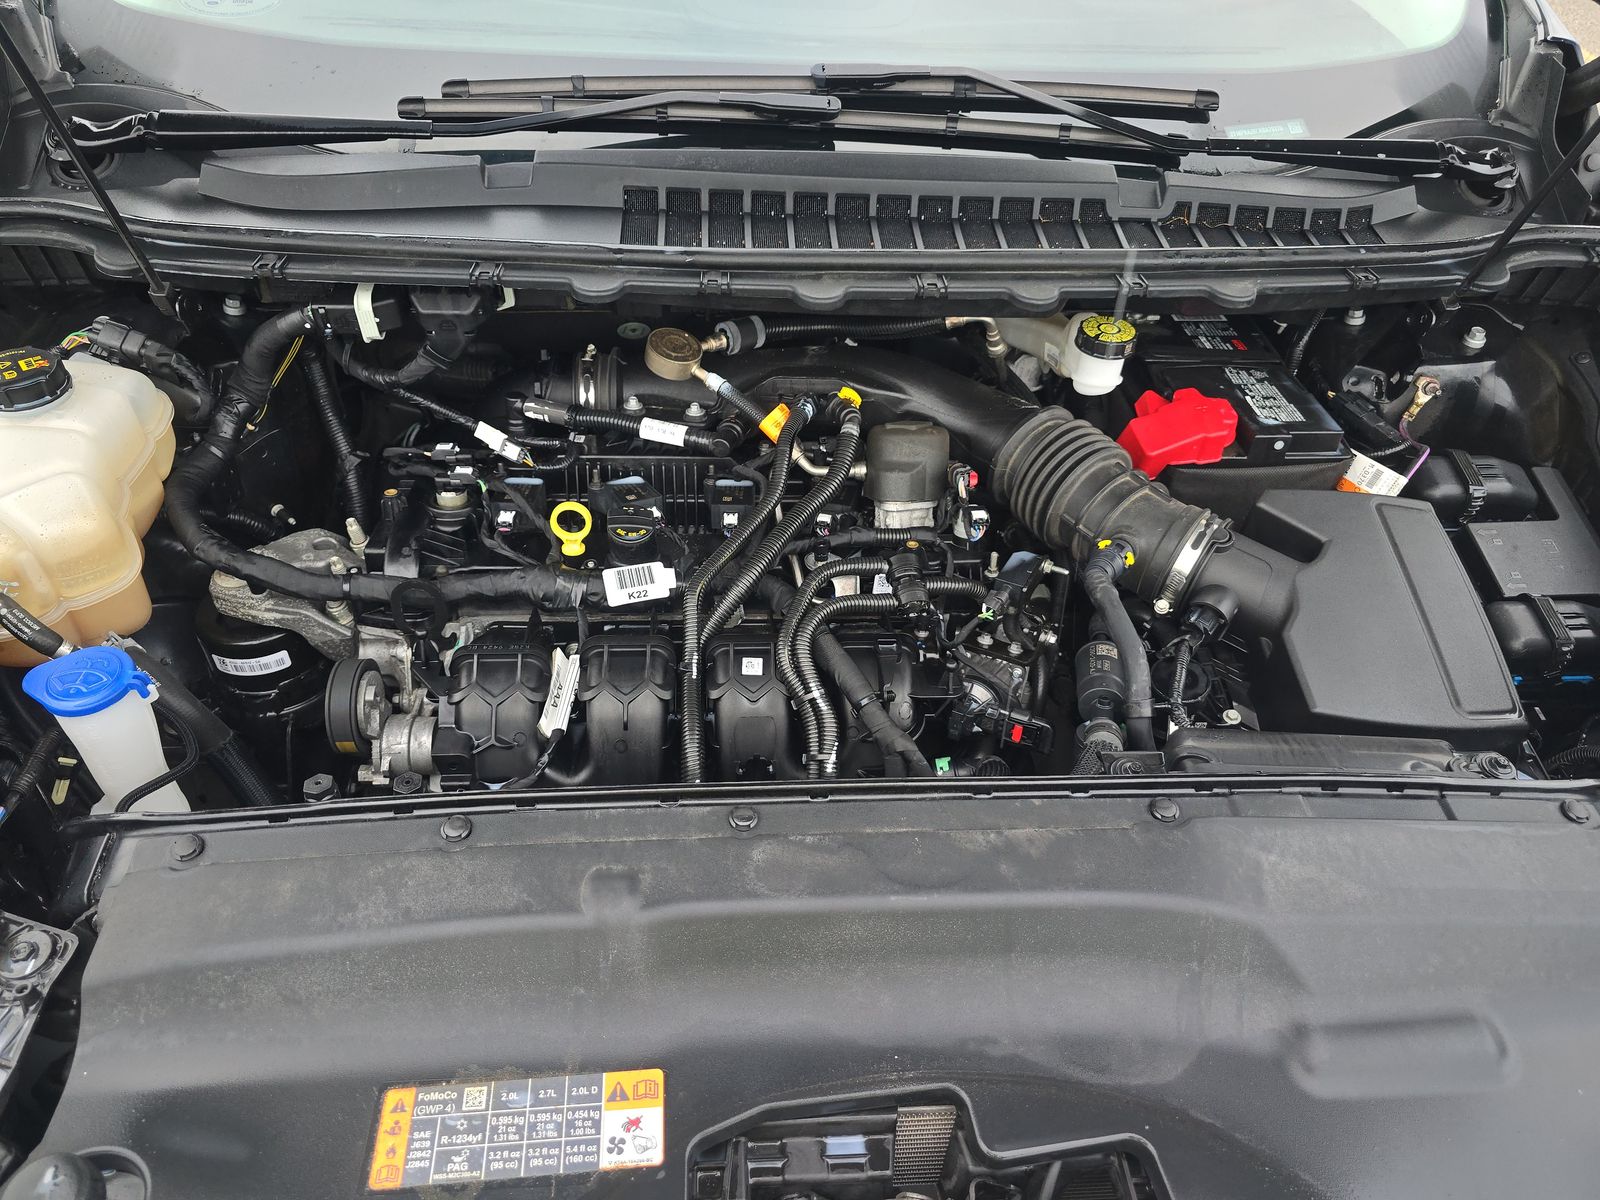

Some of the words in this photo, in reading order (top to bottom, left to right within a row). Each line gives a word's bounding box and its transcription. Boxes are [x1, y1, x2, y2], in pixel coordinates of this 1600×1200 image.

[628, 590, 648, 600] K22
[538, 1089, 556, 1098] 2.7L
[571, 1087, 589, 1095] 2.0L
[591, 1086, 598, 1094] D
[418, 1091, 458, 1101] FoMoCo
[501, 1092, 519, 1100] 2.0L
[413, 1106, 443, 1116] (GWP
[444, 1104, 455, 1113] 4)
[567, 1110, 588, 1119] 0.454
[590, 1110, 600, 1119] kg
[491, 1116, 513, 1125] 0.595
[514, 1115, 524, 1125] kg
[529, 1113, 551, 1122] 0.595
[552, 1112, 562, 1122] kg
[412, 1131, 432, 1139] SAE
[440, 1133, 482, 1145] R-1234yf
[528, 1148, 540, 1156] 3.2
[566, 1145, 578, 1153] 5.4
[407, 1150, 431, 1159] J2842
[488, 1151, 501, 1159] 3.2
[405, 1160, 430, 1168] J2845
[530, 1158, 543, 1167] (95
[544, 1157, 557, 1166] cc)
[566, 1156, 584, 1165] (160
[585, 1154, 598, 1162] cc)
[447, 1162, 469, 1172] PAG
[490, 1160, 504, 1171] (95
[505, 1160, 518, 1169] cc)
